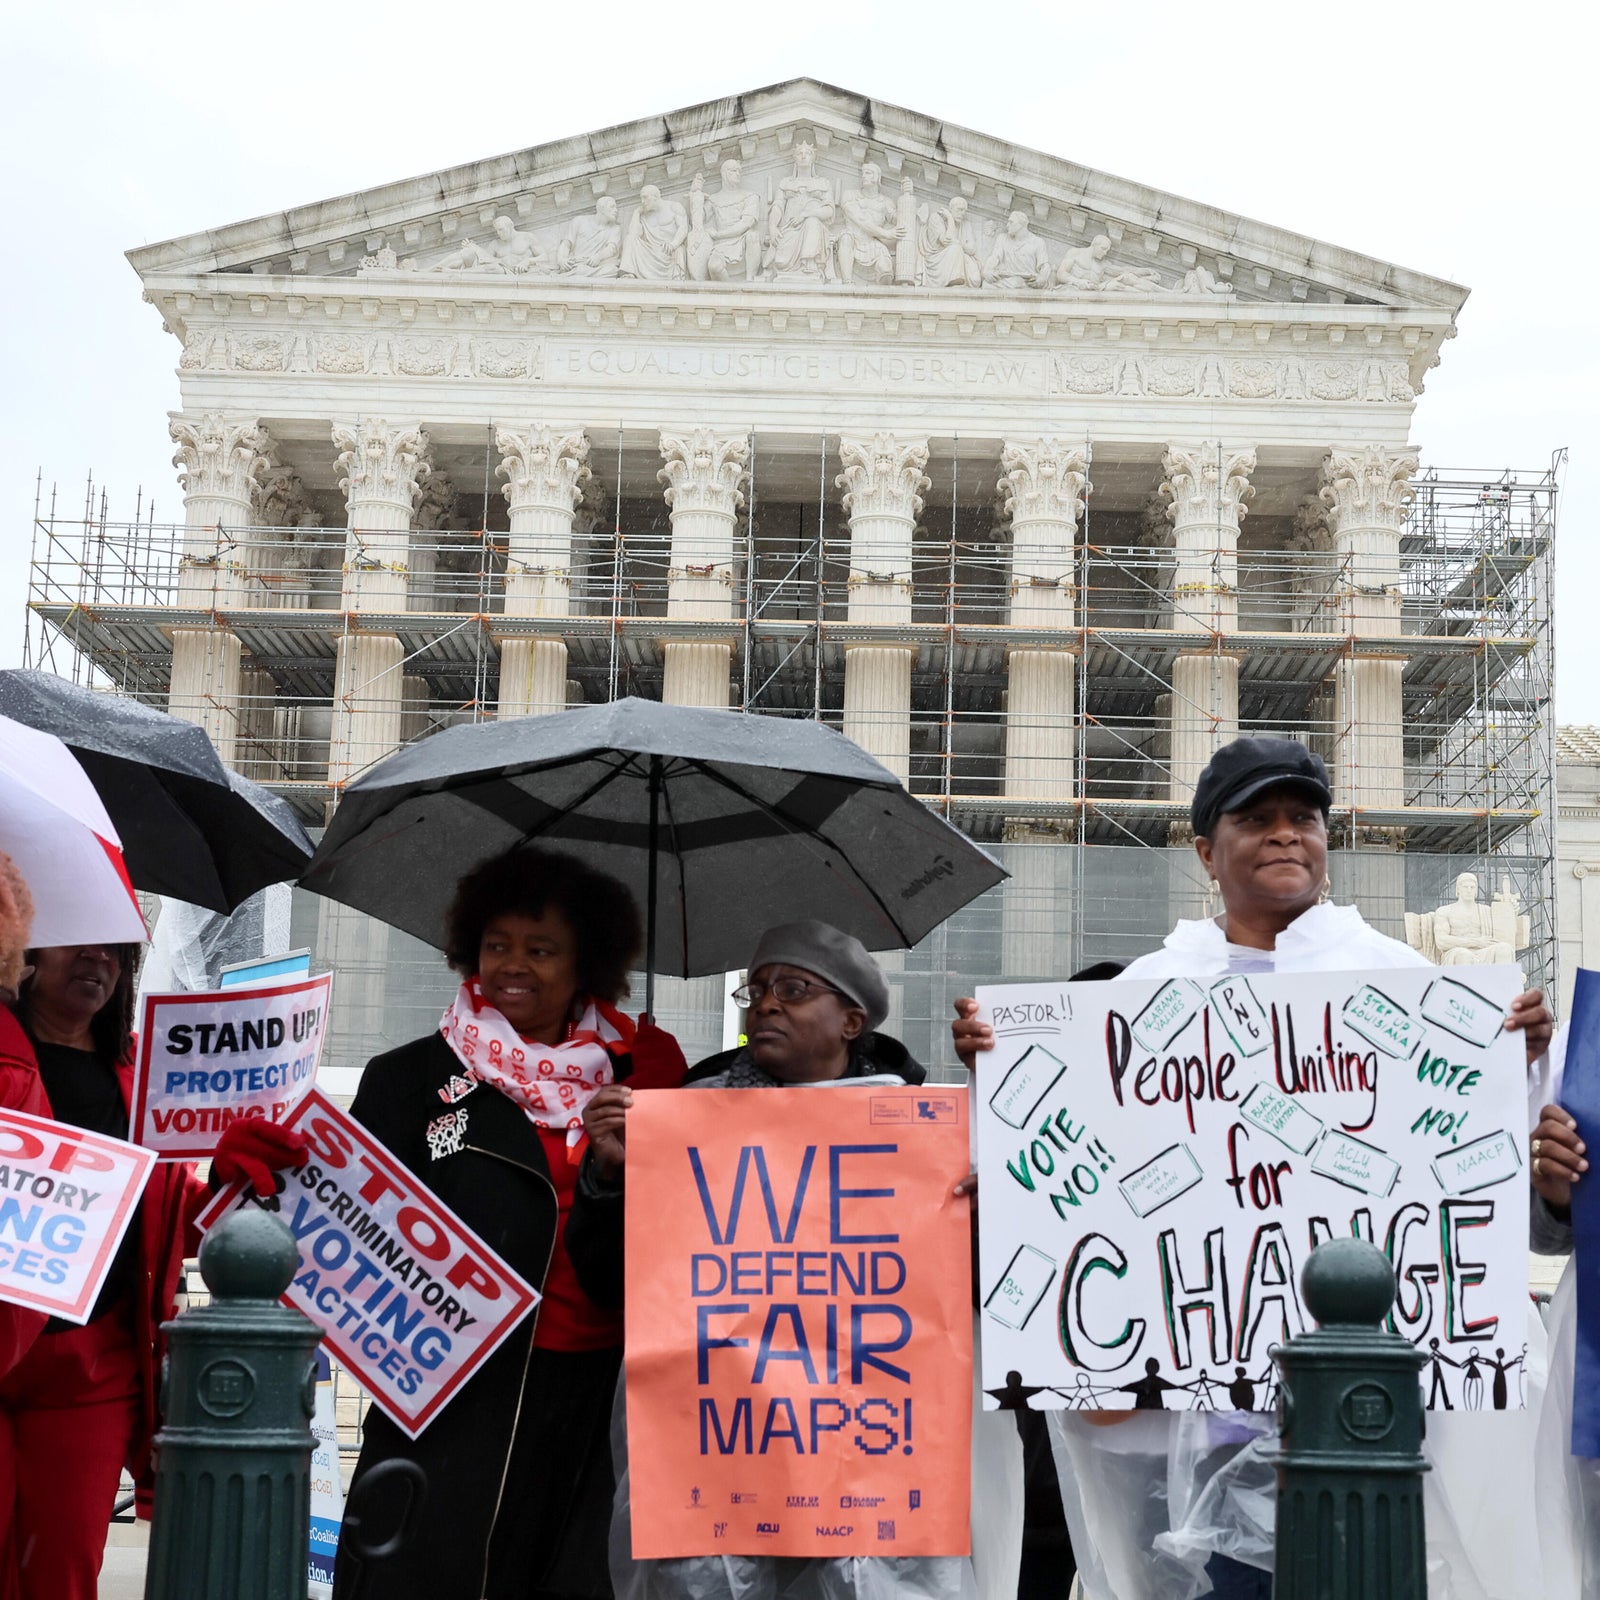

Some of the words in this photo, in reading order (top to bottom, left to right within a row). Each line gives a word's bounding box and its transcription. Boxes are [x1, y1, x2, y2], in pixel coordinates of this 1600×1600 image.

[567, 348, 680, 376] EQUAL
[688, 351, 819, 380] JUSTICE
[837, 355, 953, 382] UNDER
[961, 357, 1026, 384] LAW
[992, 993, 1073, 1027] PASTOR!!
[1351, 1006, 1409, 1047] LOUISIANA
[1363, 994, 1392, 1016] STEP
[165, 1017, 285, 1055] STAND
[292, 1006, 321, 1042] UP!
[165, 1062, 288, 1094] PROTECT
[292, 1052, 315, 1082] OUR
[1105, 1009, 1239, 1134] People
[1271, 1001, 1378, 1132] Uniting
[1417, 1048, 1482, 1096] VOTE
[1251, 1092, 1276, 1119] BLACK
[1411, 1106, 1468, 1144] NO!
[1006, 1107, 1085, 1192] VOTE
[1225, 1121, 1292, 1210] for
[1334, 1143, 1371, 1168] ACLU
[1456, 1142, 1505, 1175] NAACP
[686, 1143, 899, 1246] WE
[1049, 1133, 1116, 1222] NO!!
[301, 1117, 501, 1301] STOP
[289, 1196, 451, 1371] VOTING
[691, 1250, 907, 1298] DEFEND
[1057, 1199, 1498, 1372] CHAGE
[292, 1254, 423, 1396] ACTICES
[697, 1302, 914, 1386] FAIR
[699, 1396, 913, 1456] MAPS!
[756, 1522, 780, 1534] ACLU
[815, 1526, 854, 1537] NAACP
